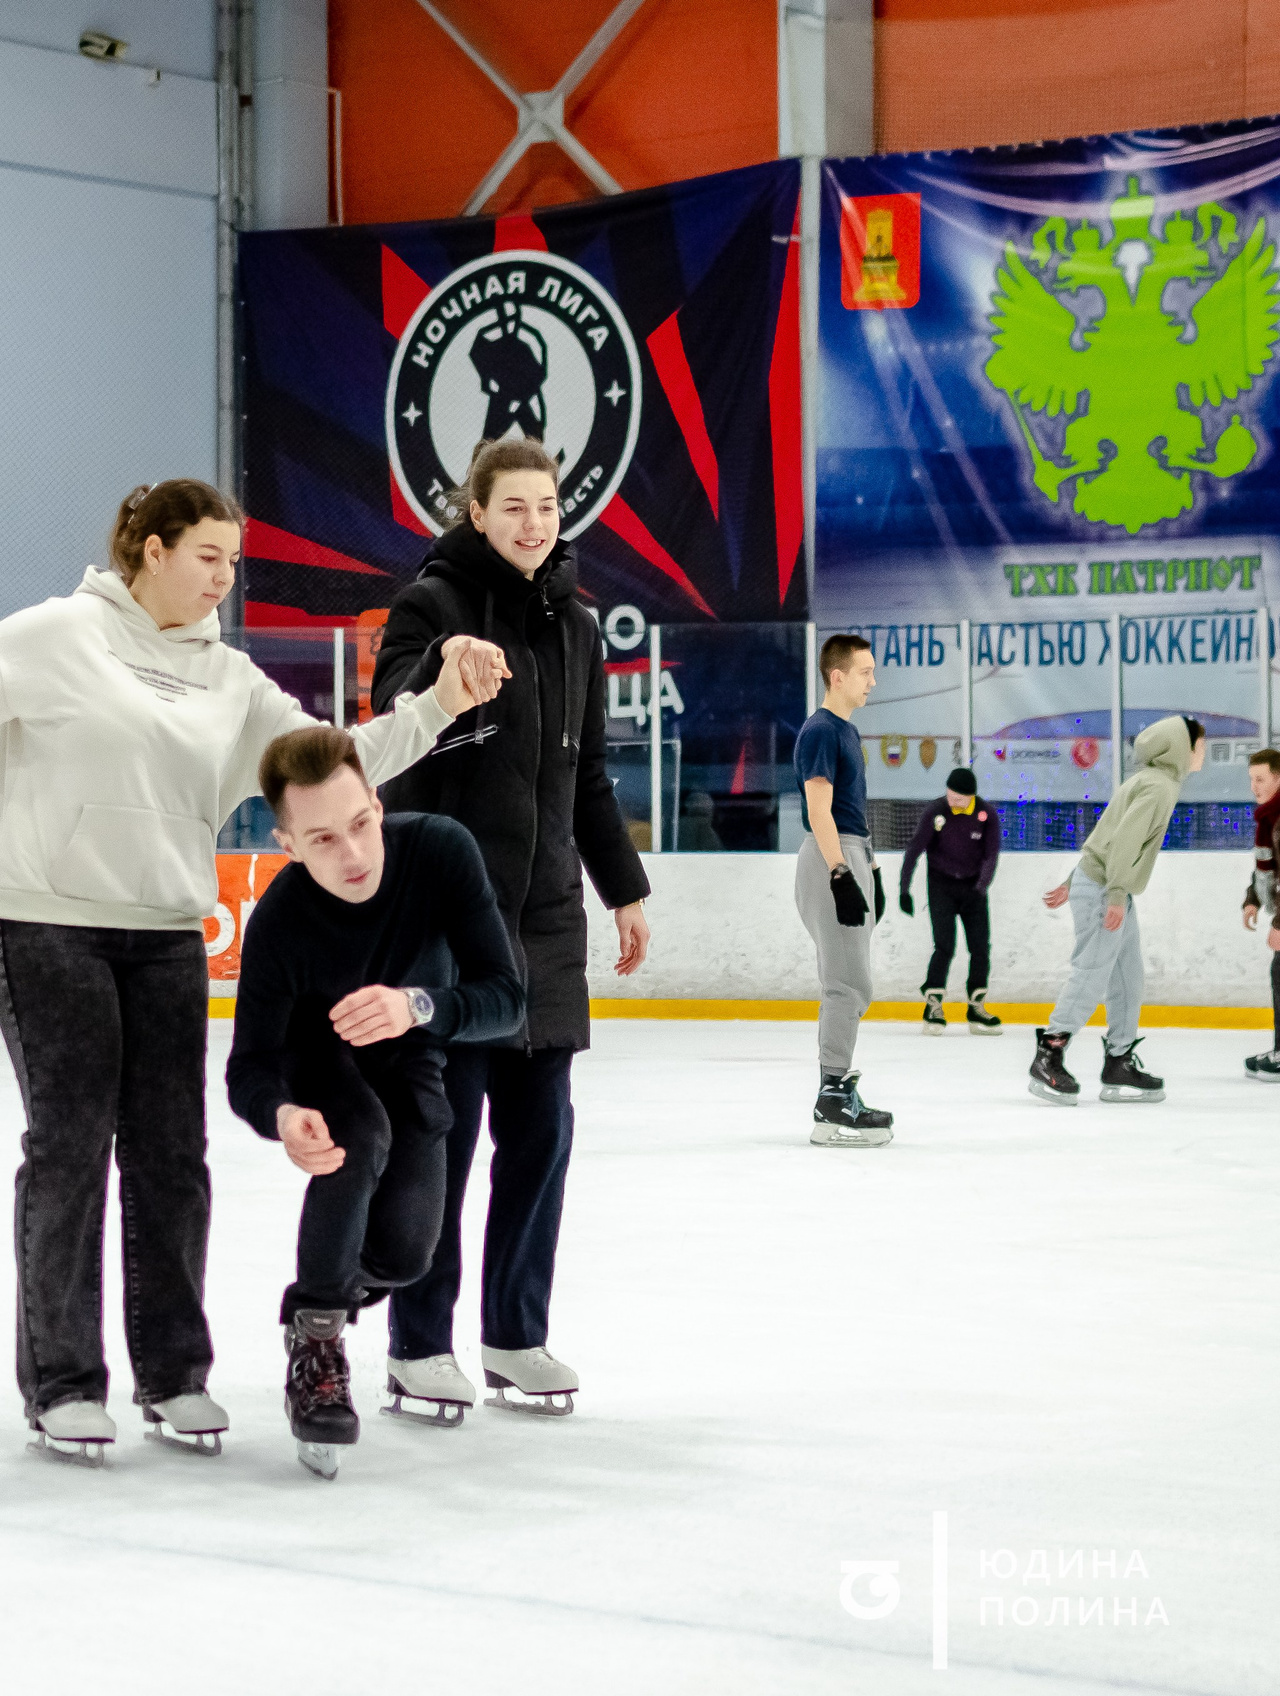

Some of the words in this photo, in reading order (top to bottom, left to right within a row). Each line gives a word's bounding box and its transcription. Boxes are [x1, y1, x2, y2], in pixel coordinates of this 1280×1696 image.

[412, 270, 526, 369] НОЧНАЯ
[537, 276, 610, 352] ЛИГА
[1003, 563, 1078, 597] ТХК
[1088, 555, 1262, 596] ПАТРИОТ
[848, 624, 946, 668] ТАНЬ
